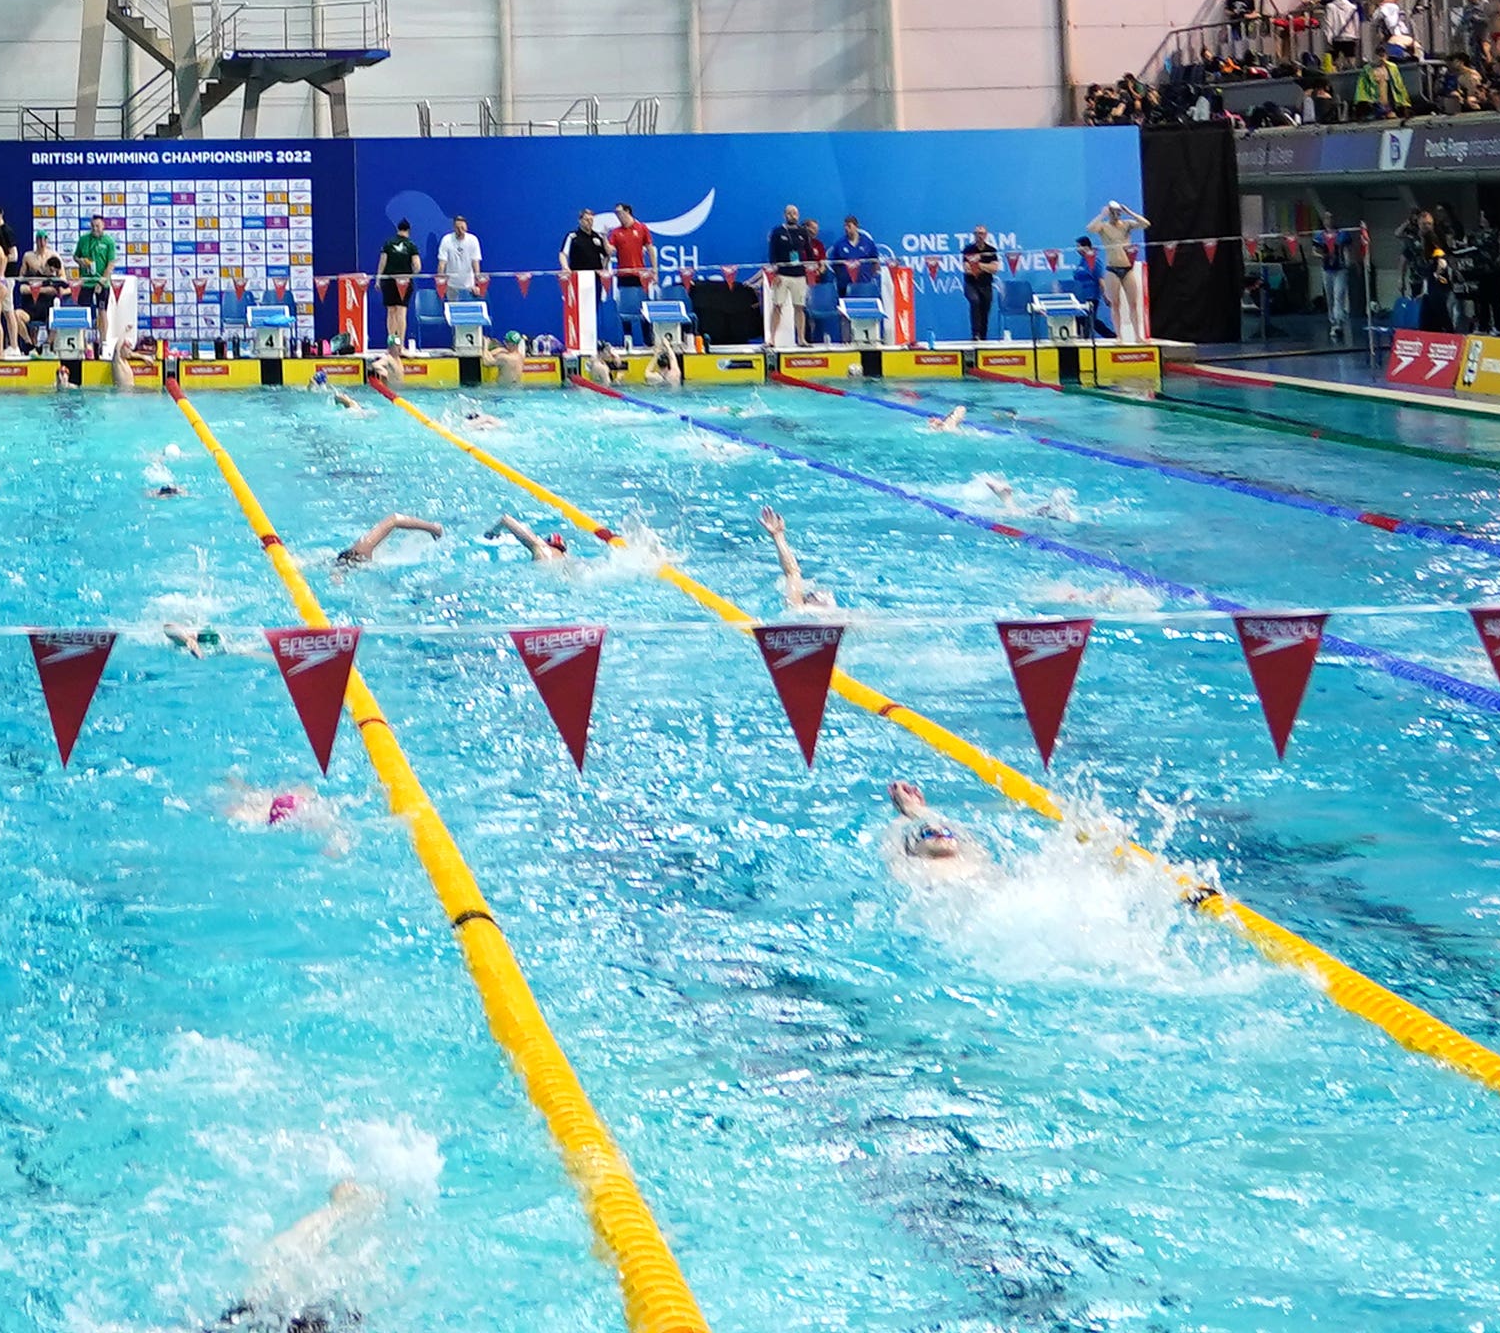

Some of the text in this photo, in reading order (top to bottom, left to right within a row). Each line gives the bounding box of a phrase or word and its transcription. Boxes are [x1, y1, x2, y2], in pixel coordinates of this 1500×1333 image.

[32, 150, 312, 164] BRITISH SWIMMING CHAMPIONSHIPS 2022
[902, 233, 949, 251] ONE
[265, 335, 274, 347] 4
[280, 628, 353, 658] speedo
[524, 626, 597, 656] speedo
[764, 628, 838, 650] speedo
[1008, 626, 1081, 650] speedo
